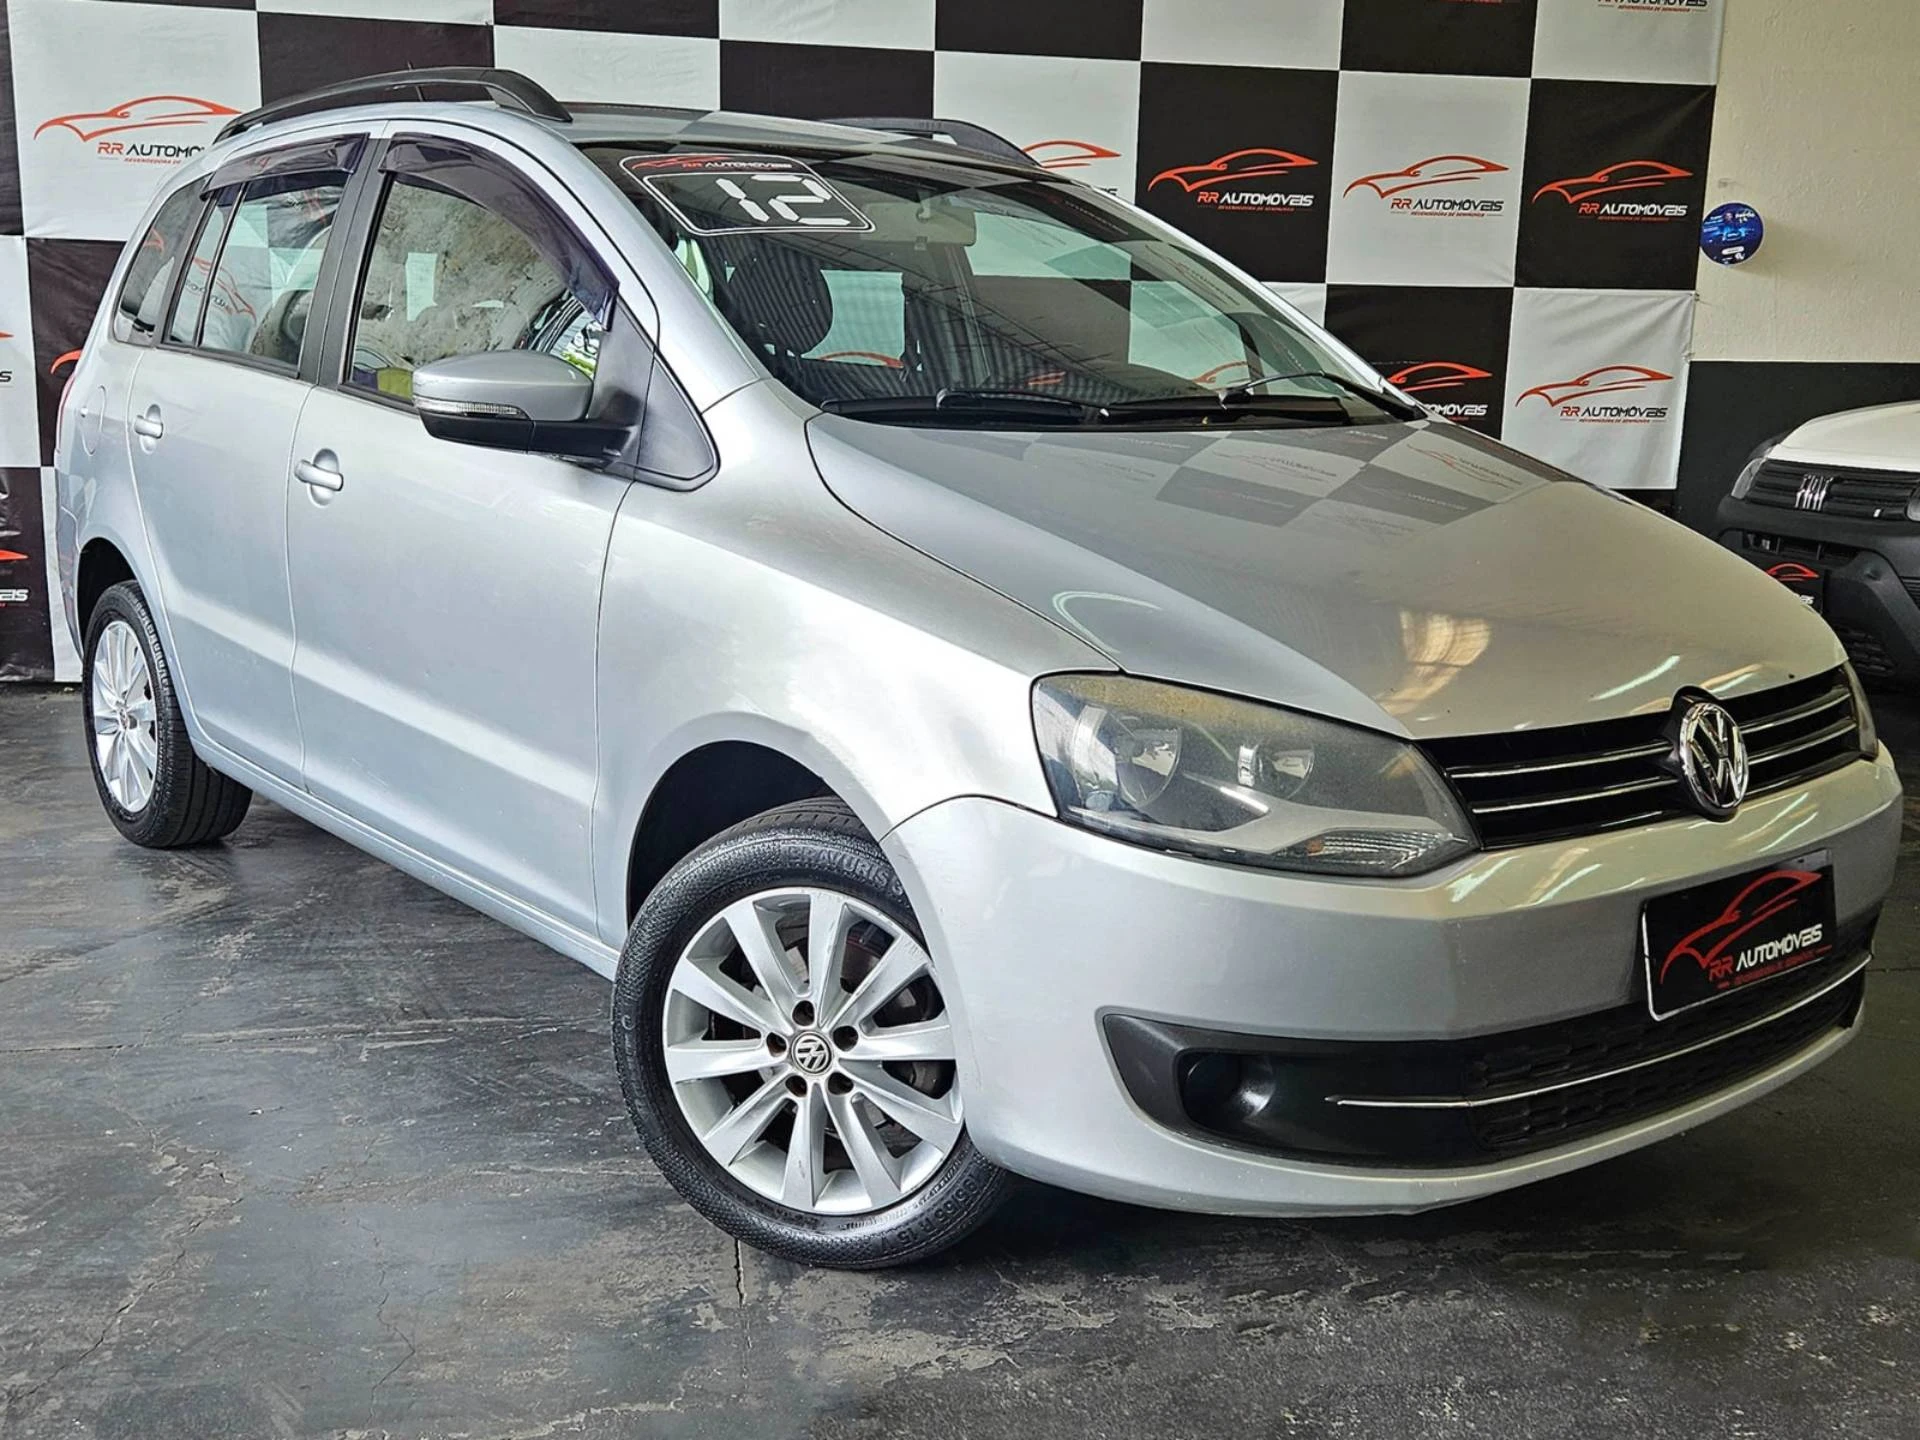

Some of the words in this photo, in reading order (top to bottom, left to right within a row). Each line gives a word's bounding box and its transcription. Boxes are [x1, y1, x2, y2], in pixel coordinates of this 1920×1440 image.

[97, 142, 124, 154] RR
[715, 174, 851, 226] 12
[1197, 191, 1219, 203] RR
[1391, 198, 1412, 209] RR
[1579, 202, 1600, 214] RR
[1560, 406, 1580, 417] RR
[1709, 955, 1734, 983] RR
